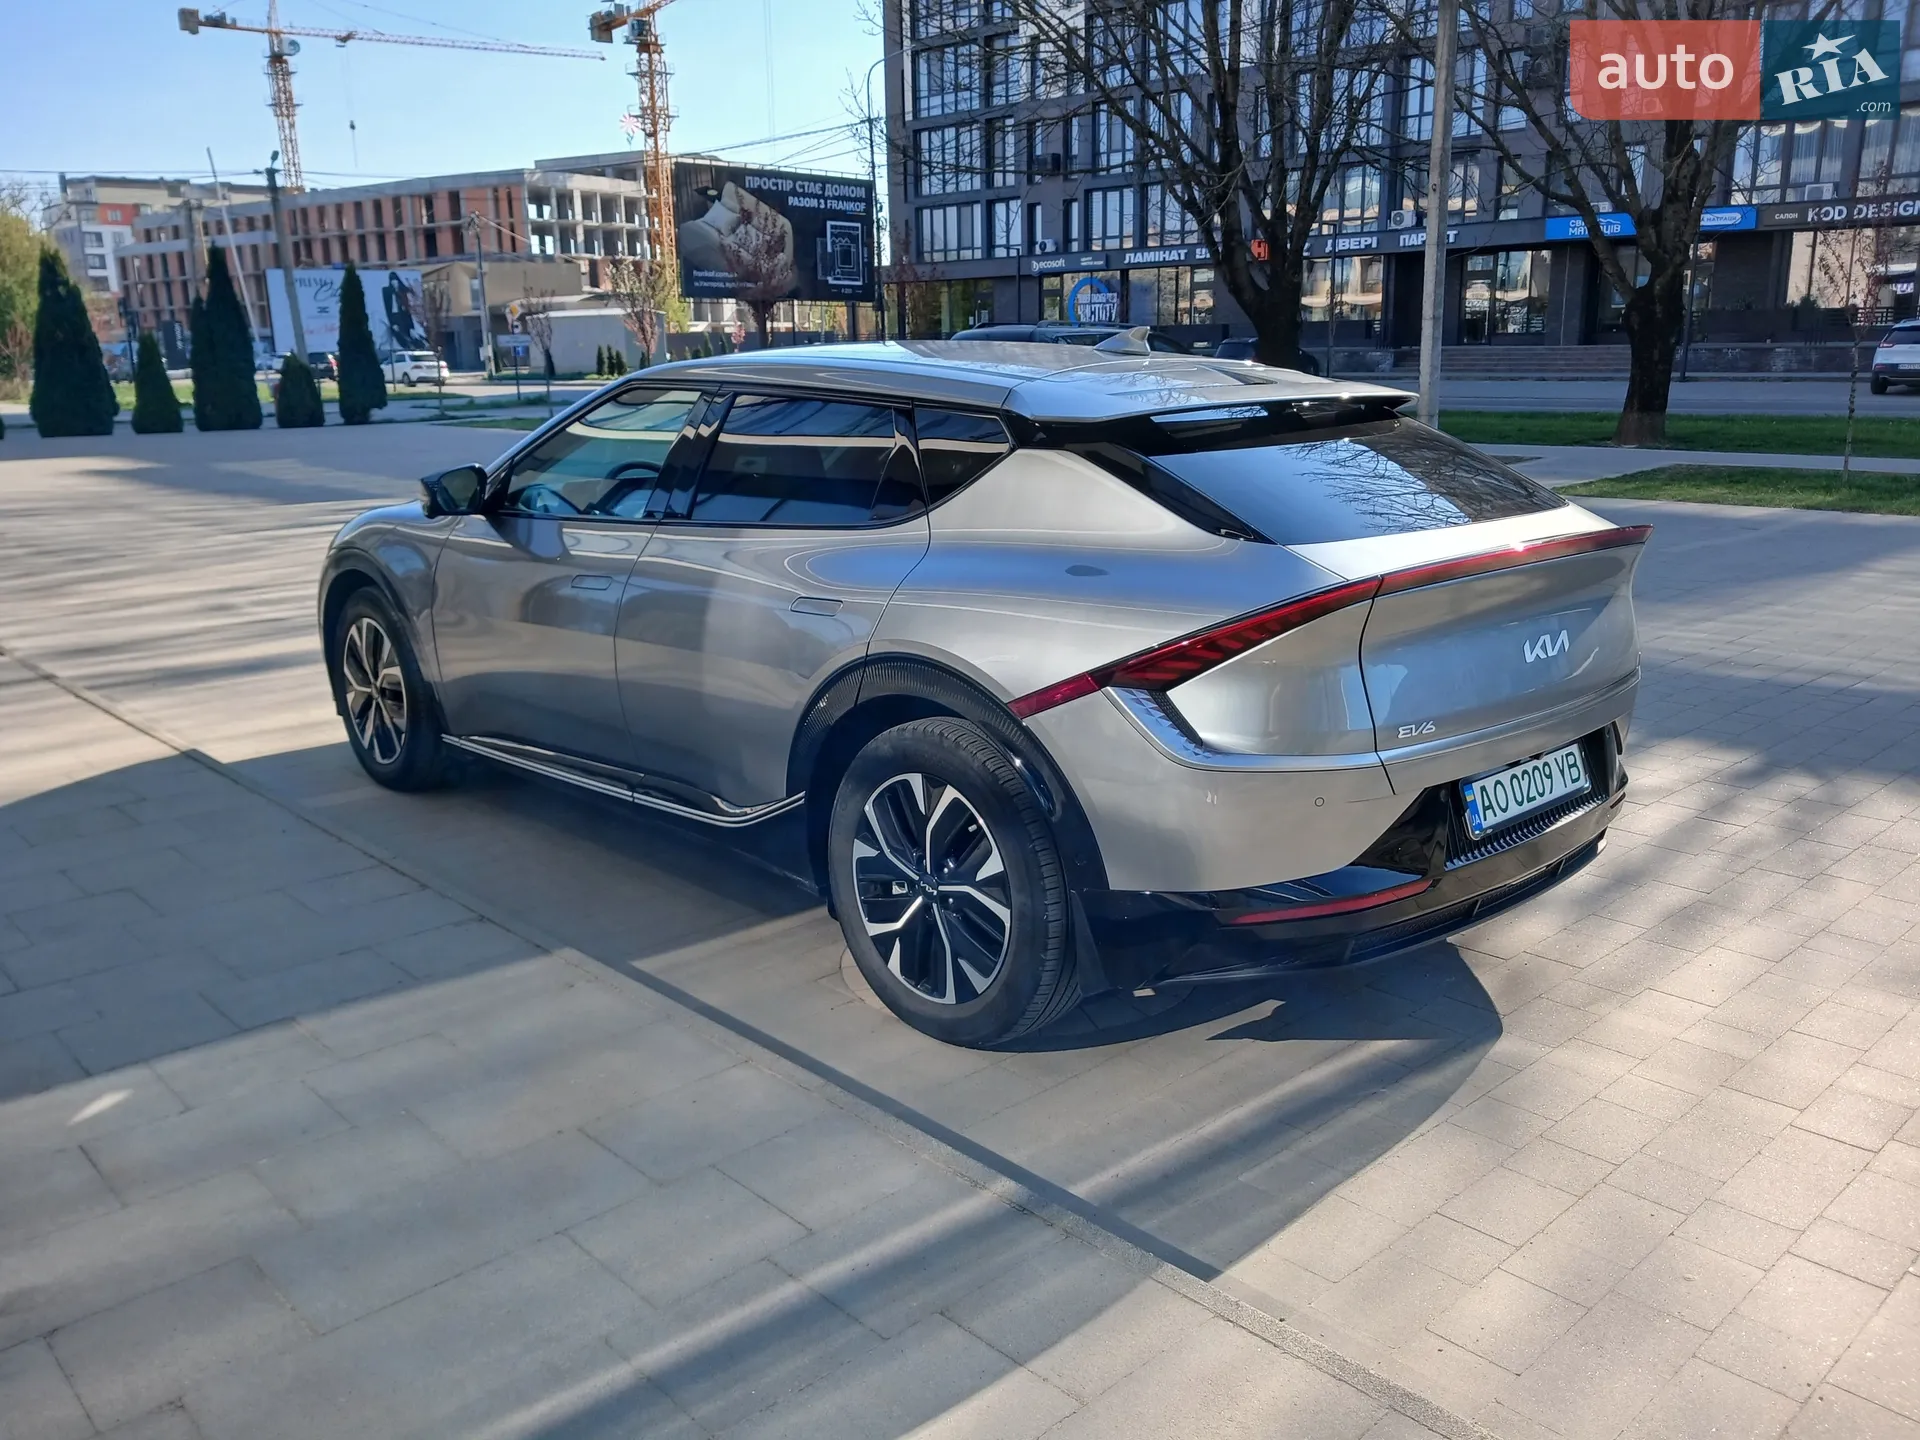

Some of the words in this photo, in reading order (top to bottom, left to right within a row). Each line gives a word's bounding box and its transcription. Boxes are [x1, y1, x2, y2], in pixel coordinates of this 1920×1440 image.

[745, 175, 793, 193] ПРОСТІР
[795, 180, 823, 193] СТАЄ
[824, 183, 866, 199] ДОМОМ
[788, 196, 818, 208] РАЗОМ
[826, 200, 867, 213] FRANKOF
[1774, 212, 1798, 220] САЛОН
[1807, 205, 1848, 222] KOD
[1399, 230, 1459, 247] ПАРТ
[1568, 224, 1621, 236] МАТЦІВ
[1039, 257, 1066, 269] ecosoft
[1123, 249, 1188, 264] ЛАМІНАТ
[1522, 629, 1570, 664] KIA
[1397, 720, 1436, 739] EV6
[1479, 779, 1509, 822] AO
[1509, 761, 1555, 807] 0209
[1554, 751, 1582, 789] YB
